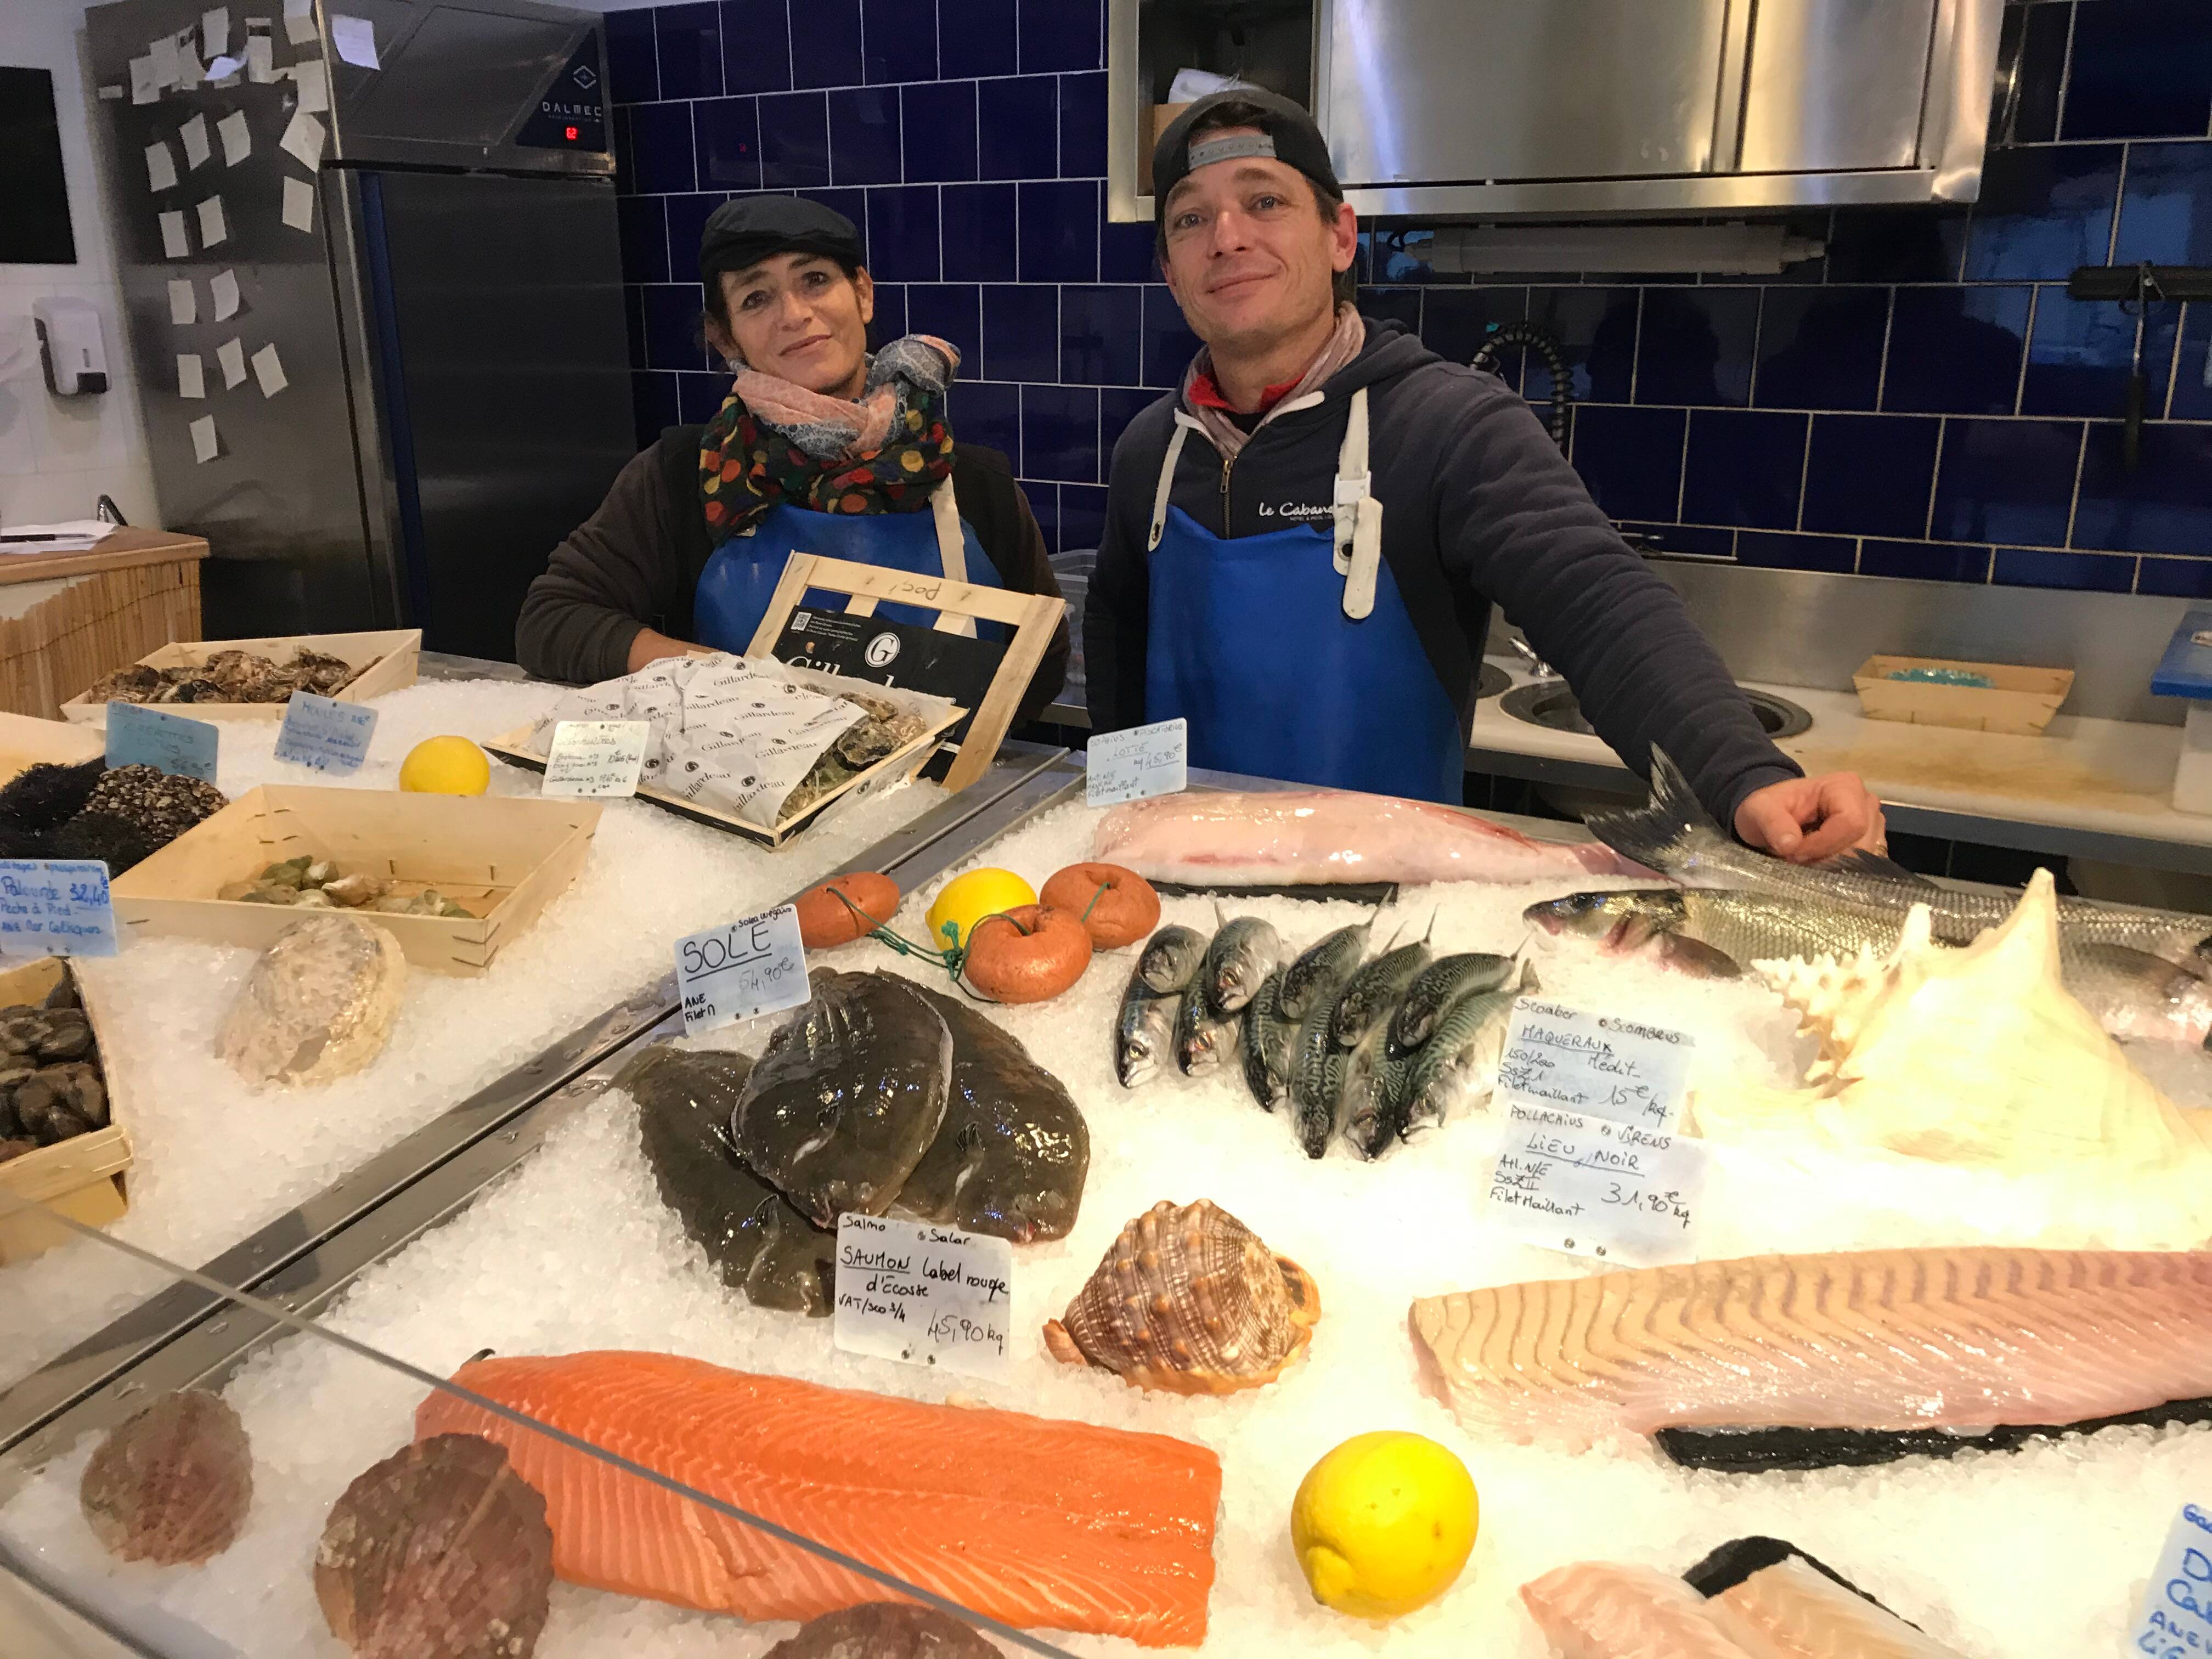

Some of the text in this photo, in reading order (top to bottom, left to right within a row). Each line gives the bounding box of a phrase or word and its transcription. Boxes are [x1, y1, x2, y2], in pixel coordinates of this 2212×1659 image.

[542, 101, 602, 117] DALMEC
[683, 921, 771, 973] SOLE
[842, 1215, 970, 1246] Salmo Salar
[840, 1246, 911, 1270] SAUMON
[966, 1275, 1009, 1303] rouge
